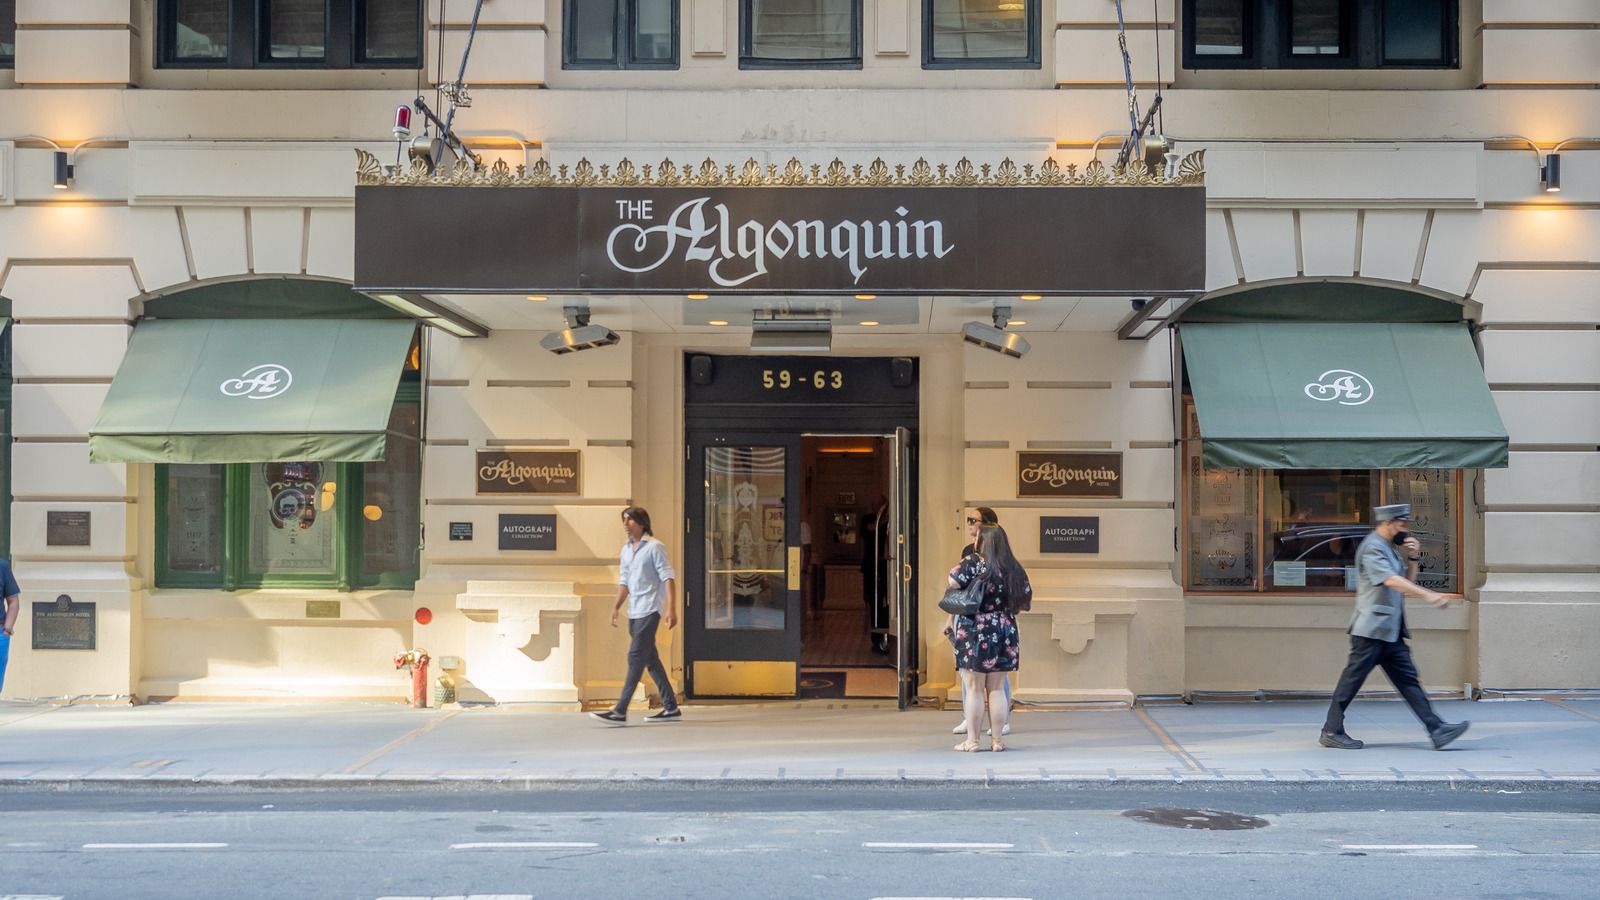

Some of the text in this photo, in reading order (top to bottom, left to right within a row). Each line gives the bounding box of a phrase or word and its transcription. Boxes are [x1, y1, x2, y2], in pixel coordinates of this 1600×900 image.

[616, 199, 654, 220] THE
[606, 196, 955, 287] Algonquin
[479, 459, 575, 485] Algonquin
[1021, 461, 1118, 488] Algonquin
[503, 525, 552, 533] AUTOGRAPH
[1045, 528, 1095, 536] AUTOGRAPH
